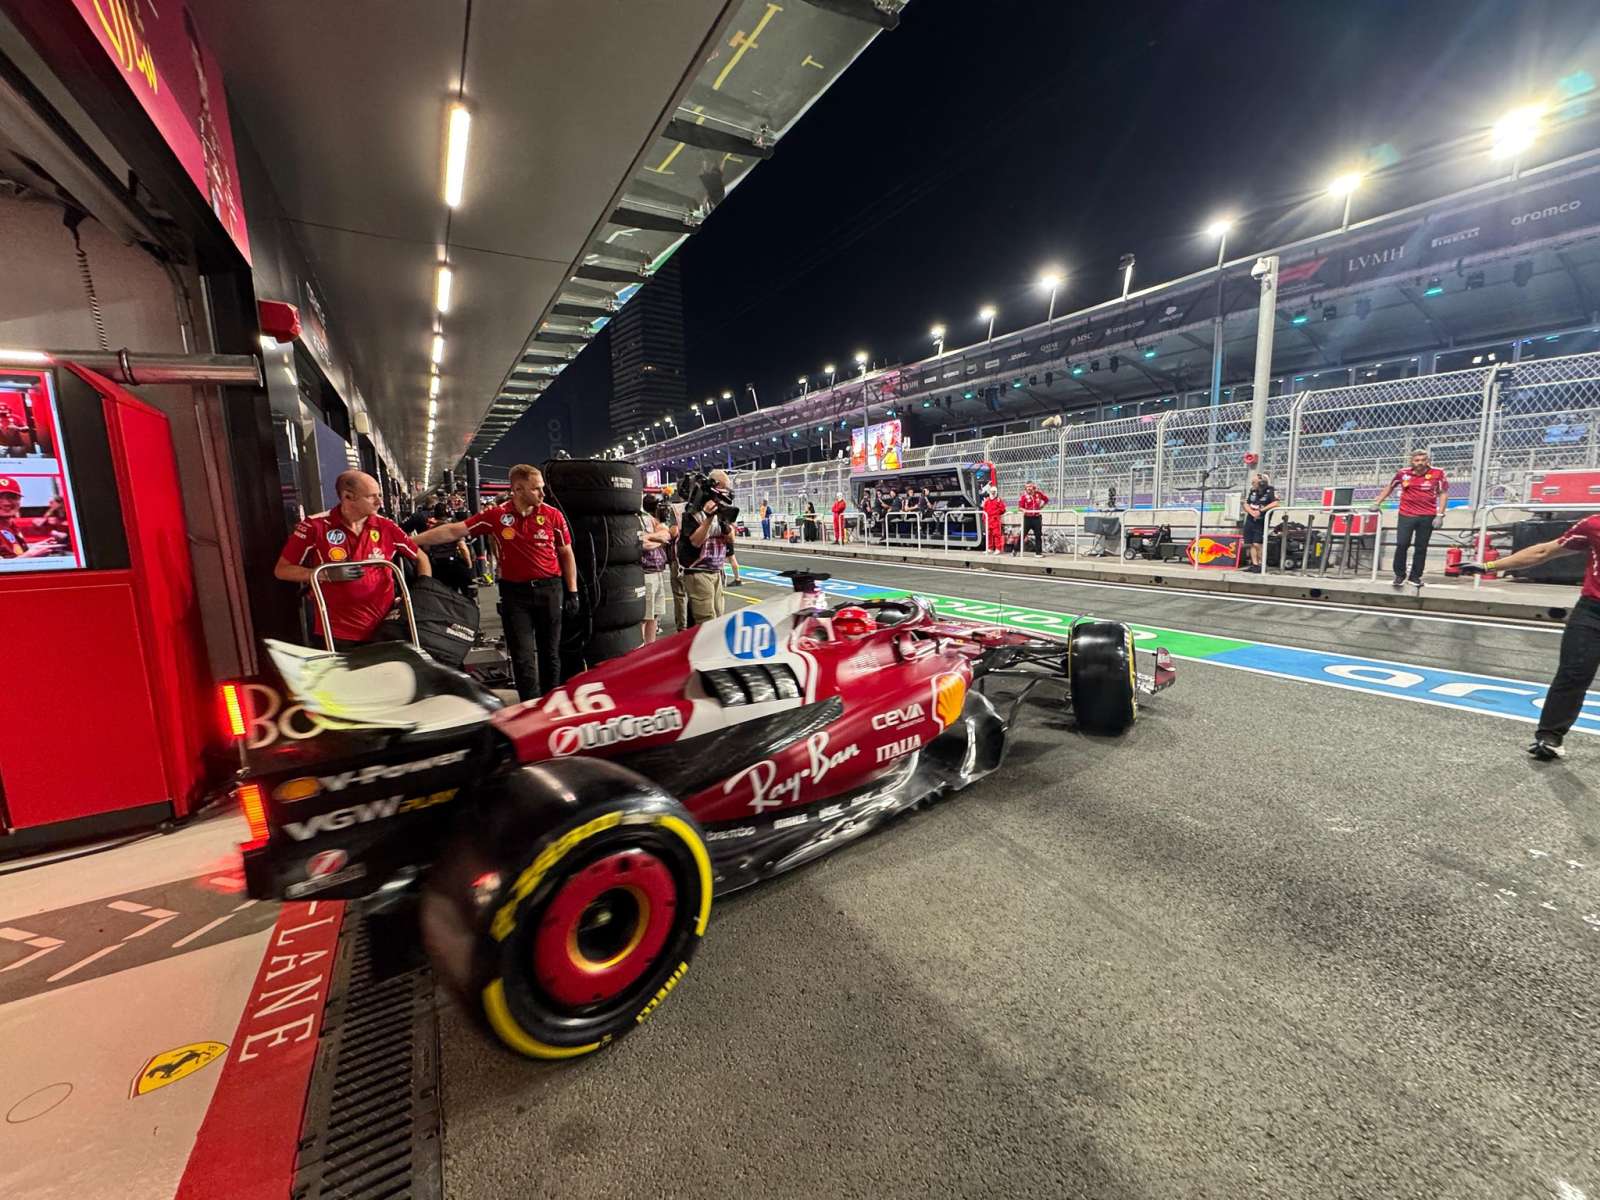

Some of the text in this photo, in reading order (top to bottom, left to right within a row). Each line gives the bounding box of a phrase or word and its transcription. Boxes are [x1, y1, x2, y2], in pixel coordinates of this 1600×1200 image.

[1510, 199, 1582, 227] aramco
[1430, 226, 1481, 249] PIRELLI
[1348, 246, 1405, 272] LVMH
[328, 529, 345, 544] hp
[730, 610, 773, 660] hp
[542, 681, 617, 718] 16
[579, 705, 684, 749] UniCredit
[876, 734, 922, 763] ITALIA
[319, 749, 472, 792] V-Power
[723, 731, 861, 814] Ray-Ban
